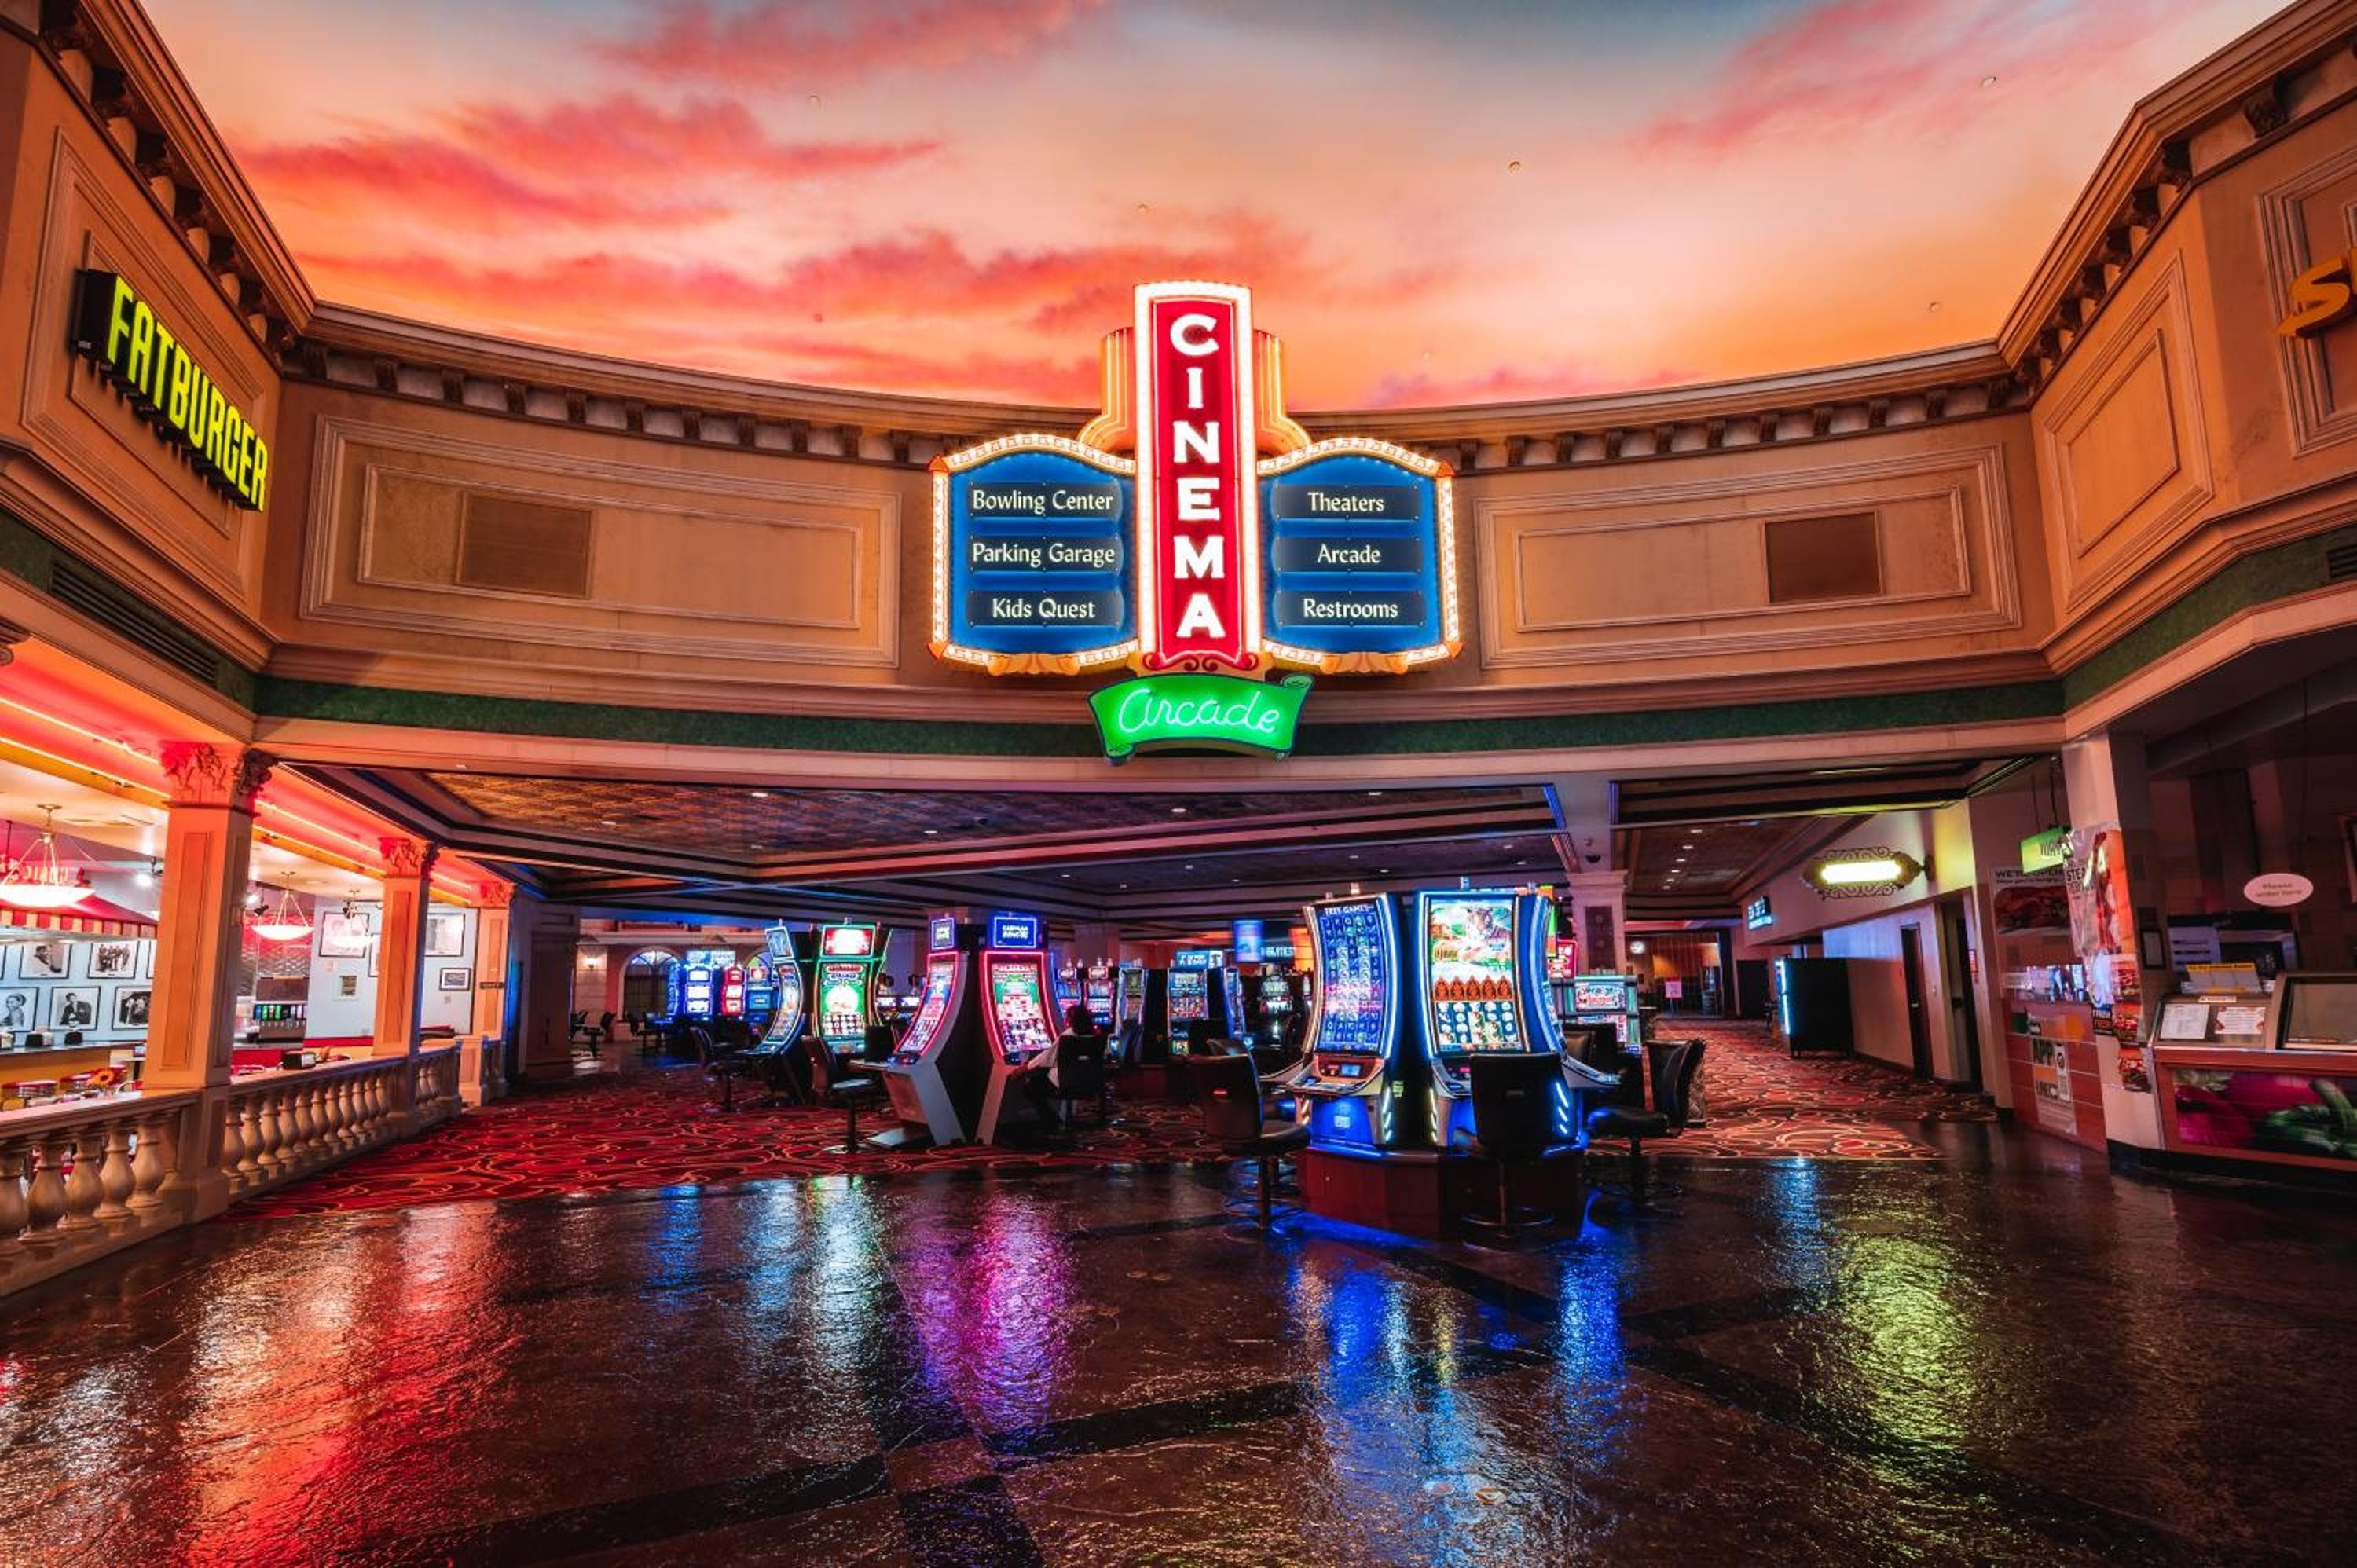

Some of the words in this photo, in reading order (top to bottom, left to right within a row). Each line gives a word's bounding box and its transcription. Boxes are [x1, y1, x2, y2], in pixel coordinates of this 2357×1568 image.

[2278, 247, 2357, 335] S
[108, 275, 268, 512] FATBURGER
[1169, 313, 1225, 639] CINEMA
[973, 489, 1045, 515] Bowling
[1052, 490, 1113, 510] Center
[1307, 492, 1384, 511] Theaters
[972, 543, 1041, 567] Parking
[1048, 543, 1115, 568] Garage
[1318, 544, 1380, 563] Arcade
[992, 599, 1032, 617] Kids
[1039, 598, 1095, 618] Quest
[1303, 598, 1398, 618] Restrooms
